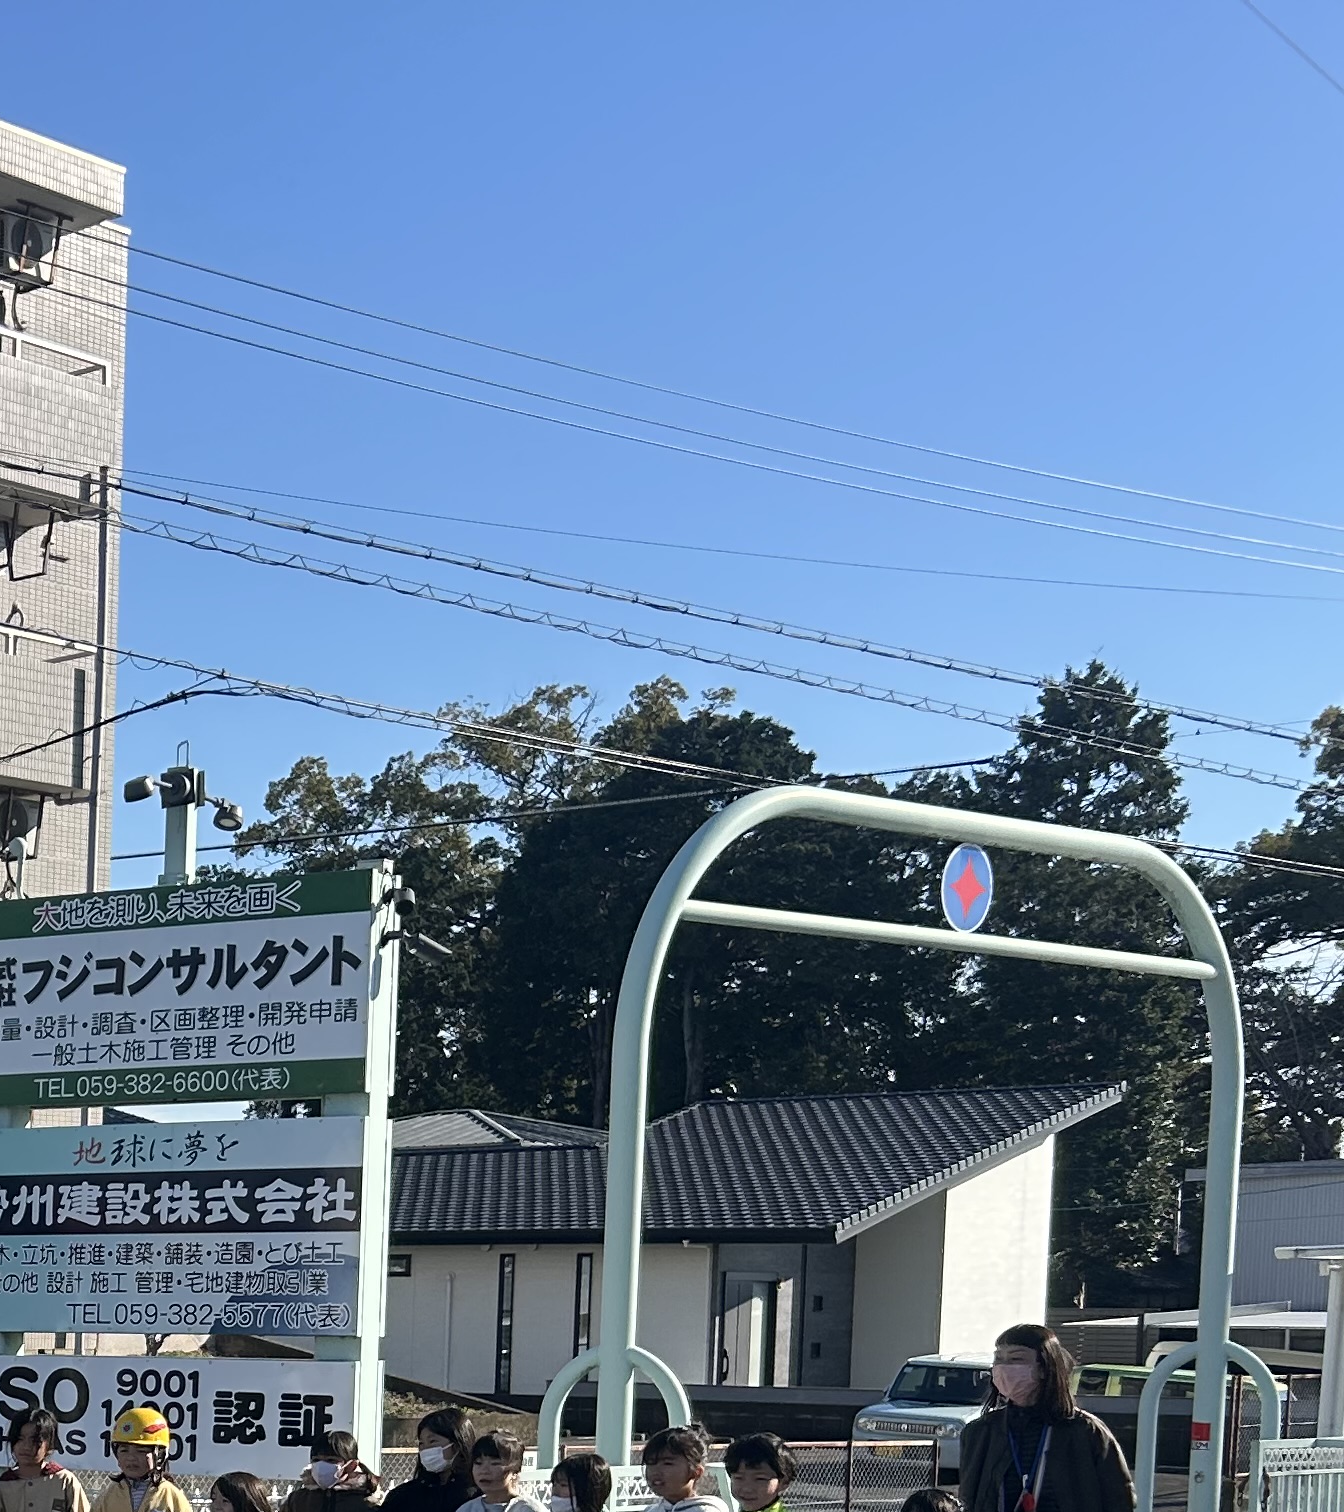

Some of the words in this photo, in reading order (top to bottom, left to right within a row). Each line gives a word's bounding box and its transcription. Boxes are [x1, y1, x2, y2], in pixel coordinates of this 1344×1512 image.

[32, 880, 301, 933] 大地を測り、未来を画く
[21, 935, 362, 1005] フジコンサルタント
[31, 1035, 217, 1067] 一般土木施工管理
[226, 1031, 296, 1057] その他
[72, 1132, 239, 1168] 地球に夢を
[47, 1272, 84, 1294] 設計
[90, 1272, 127, 1294] 施工
[116, 1368, 200, 1399] 9001
[100, 1431, 197, 1462] 101
